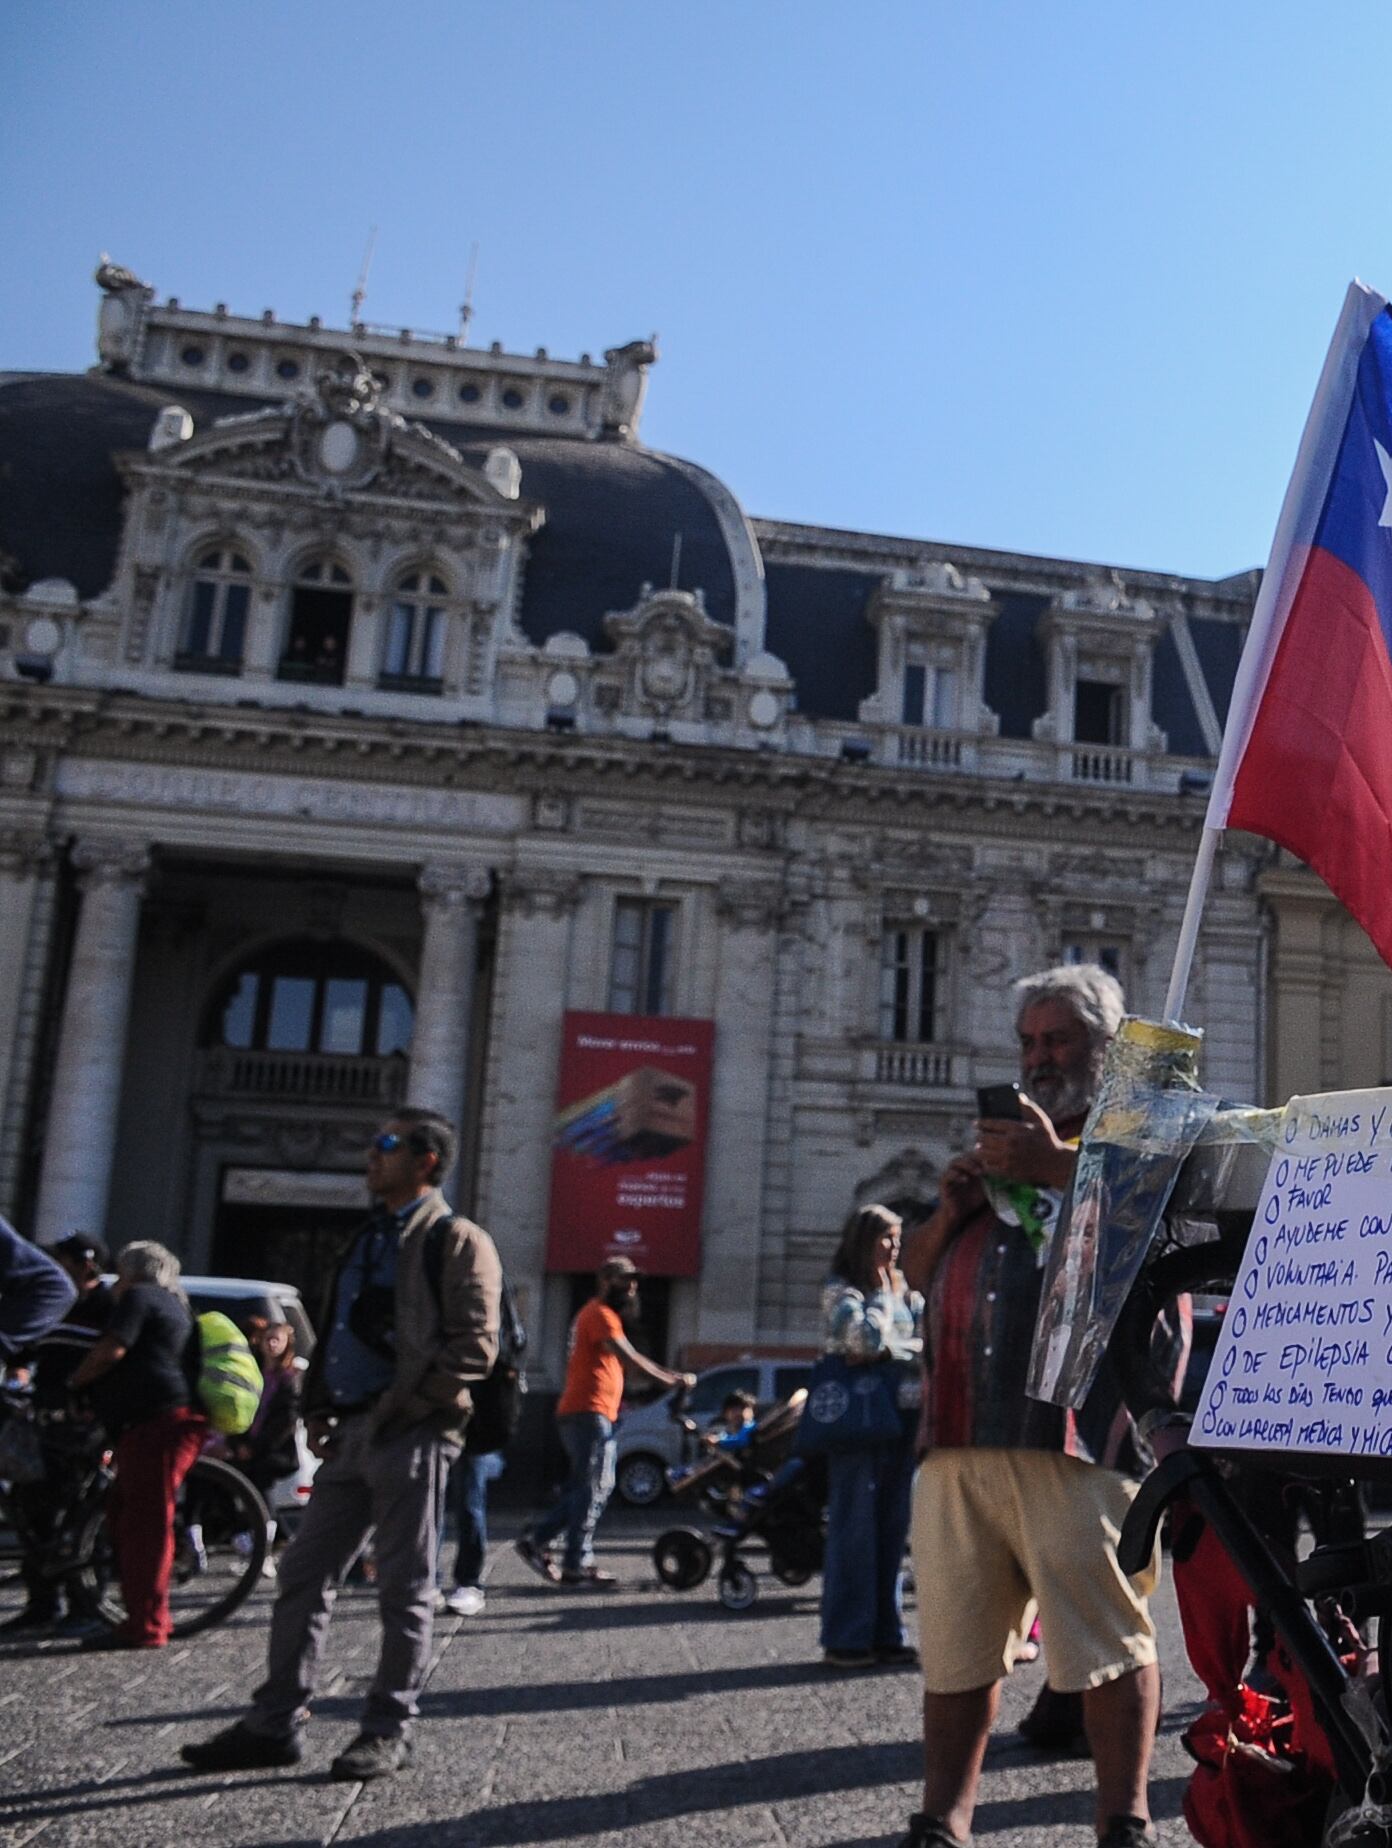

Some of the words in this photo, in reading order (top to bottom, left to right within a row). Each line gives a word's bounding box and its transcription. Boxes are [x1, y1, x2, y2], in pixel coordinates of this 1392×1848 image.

[1310, 1114, 1361, 1140] DAMAS
[1371, 1106, 1387, 1147] Y
[1294, 1157, 1321, 1182] ME
[1323, 1151, 1378, 1181] PUEDE
[1288, 1183, 1332, 1212] FAVOR
[1274, 1219, 1349, 1254] AYUDEME
[1243, 1351, 1267, 1373] DE
